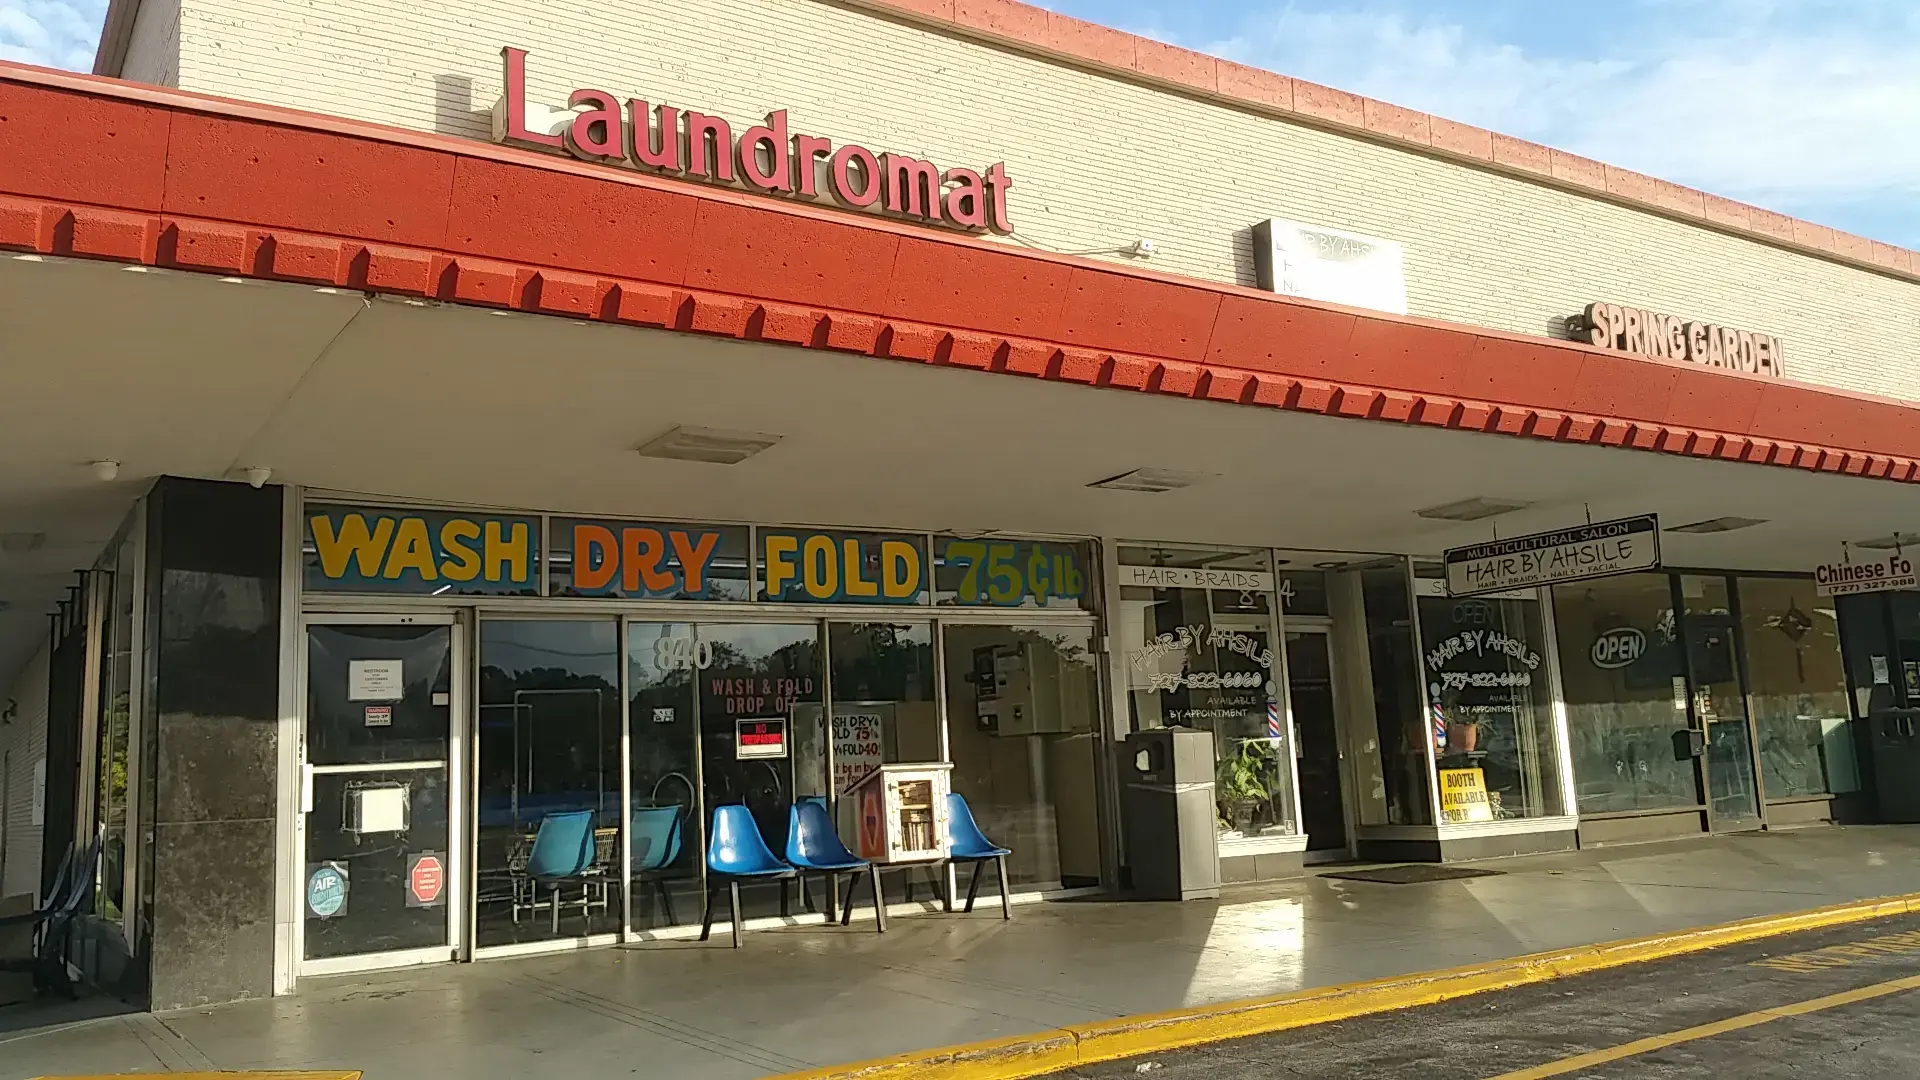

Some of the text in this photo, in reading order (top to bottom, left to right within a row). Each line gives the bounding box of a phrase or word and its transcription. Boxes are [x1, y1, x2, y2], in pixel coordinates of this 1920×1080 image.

[502, 46, 1015, 234] Laundromat
[1588, 301, 1785, 378] SPRING GARDEN
[1466, 523, 1629, 560] MULTICULTURAL SALON
[310, 513, 529, 583] WASH
[574, 524, 720, 592] DRY
[765, 534, 920, 599] FOLD
[1466, 539, 1632, 582] HAIR BY AHSILE
[1133, 568, 1260, 587] HAIR BRAIDS
[1477, 562, 1621, 589] HAIR BRAIDS NAILS FACIAL
[1816, 556, 1911, 584] Chinese Fo
[1828, 584, 1859, 594] (727)
[1453, 603, 1493, 625] OPEN
[656, 635, 713, 670] 840
[1131, 624, 1275, 671] HAIR BY AHSILE
[1427, 629, 1541, 672] HAIR BY AHSILE
[1598, 635, 1640, 661] OPEN
[712, 678, 812, 695] WASH & FOLD
[1148, 672, 1262, 693] 727-322-6060
[1441, 672, 1531, 690] 727-322-6060
[727, 696, 799, 714] DROP OFF
[1207, 696, 1257, 704] AVAILABLE
[1459, 705, 1521, 714] BY APPOINTMENT
[850, 715, 874, 727] DRY
[1169, 708, 1248, 721] BY APPOINTMENT
[755, 723, 767, 733] NO
[1447, 773, 1476, 788] BOOTH
[1444, 791, 1486, 806] AVAILABLE
[313, 876, 337, 893] AIR
